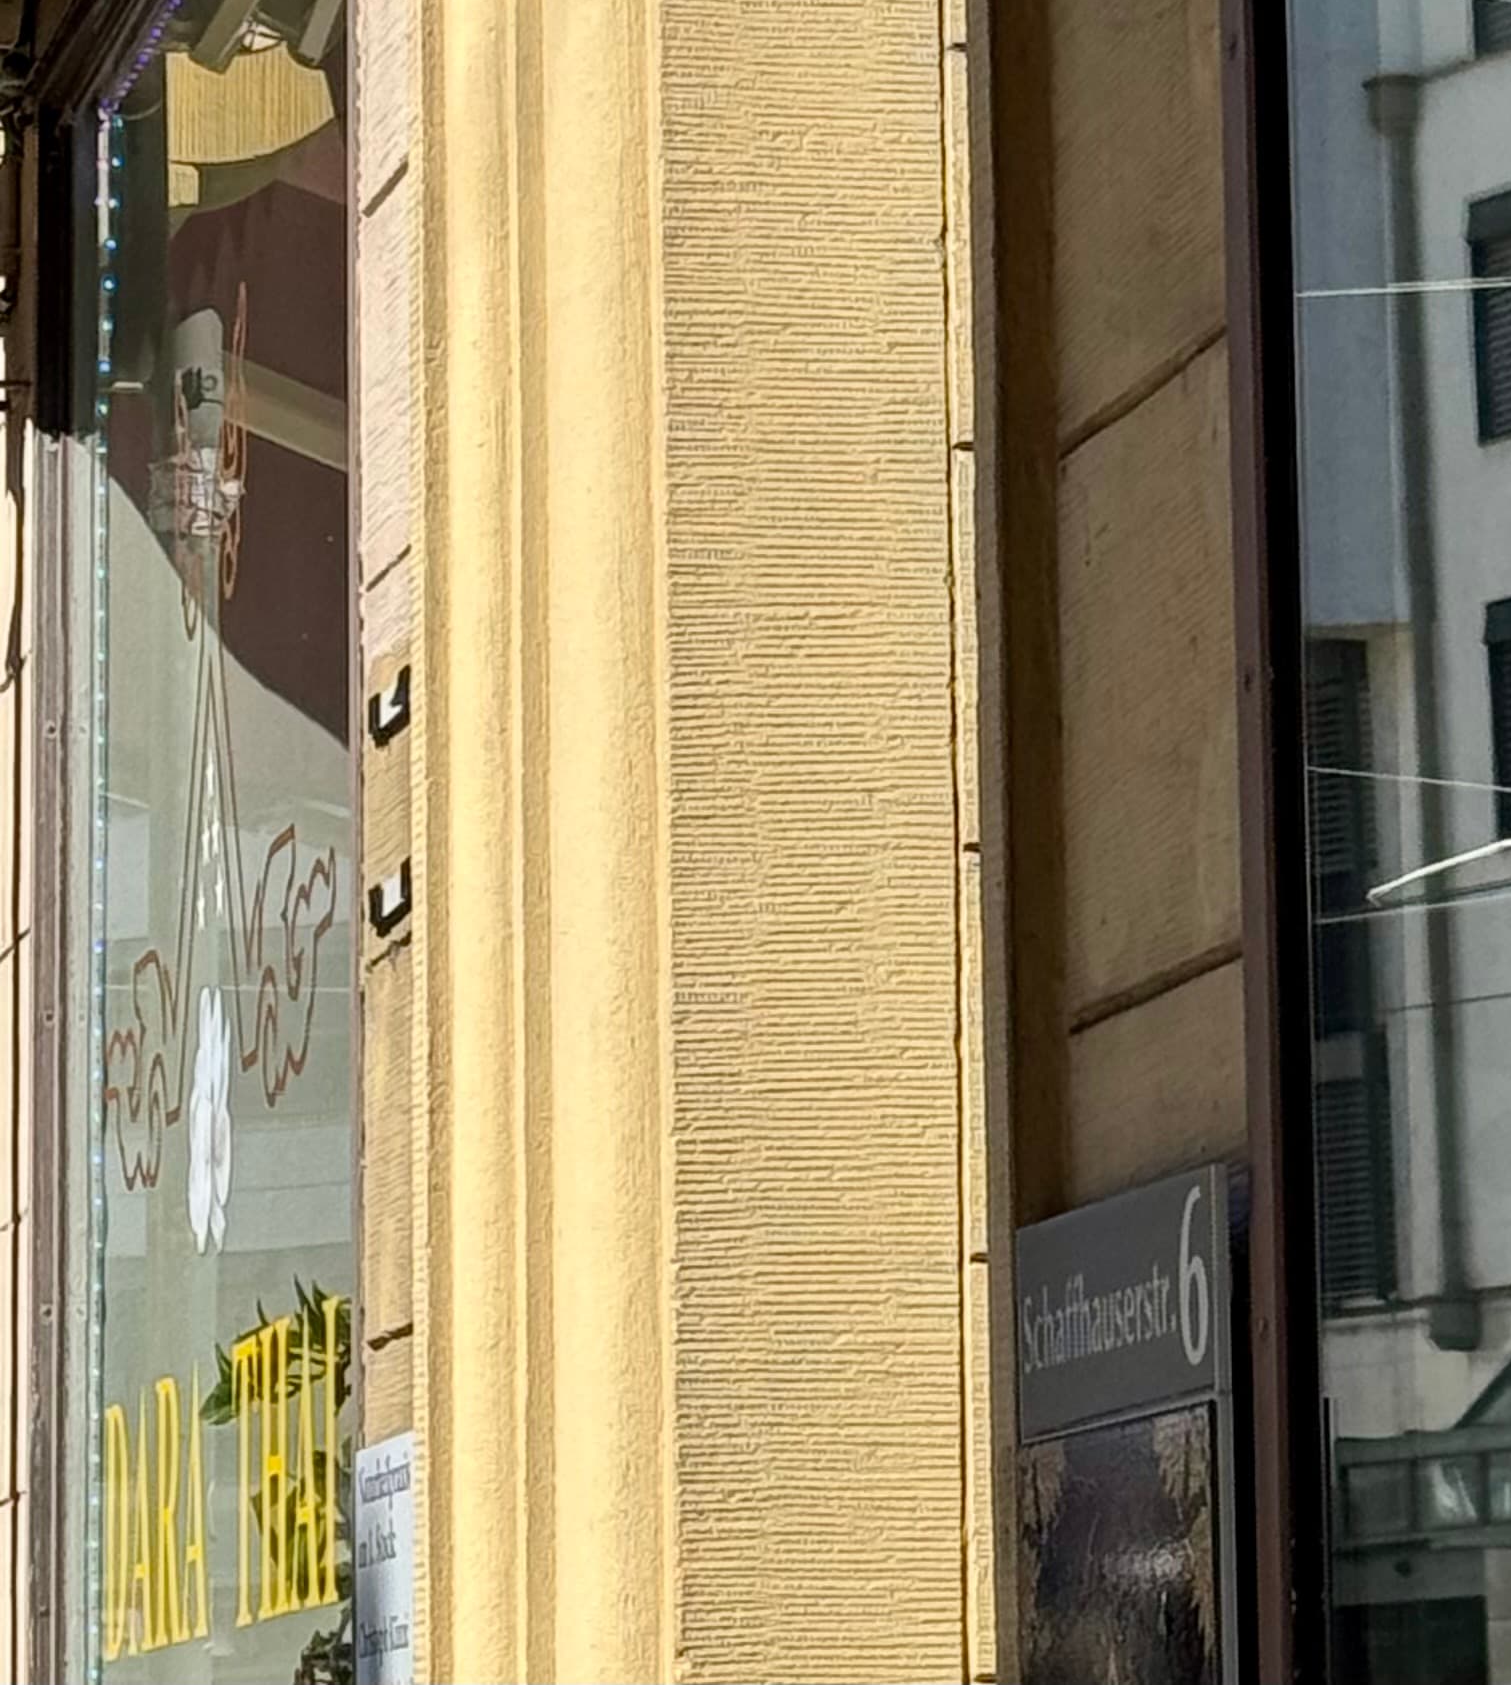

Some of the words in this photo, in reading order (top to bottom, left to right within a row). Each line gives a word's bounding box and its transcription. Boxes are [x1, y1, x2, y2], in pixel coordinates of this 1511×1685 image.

[1024, 1261, 1176, 1374] Schaffhauserstr.
[1178, 1185, 1209, 1366] 6
[104, 1360, 209, 1662] DARA
[232, 1295, 339, 1626] THAI
